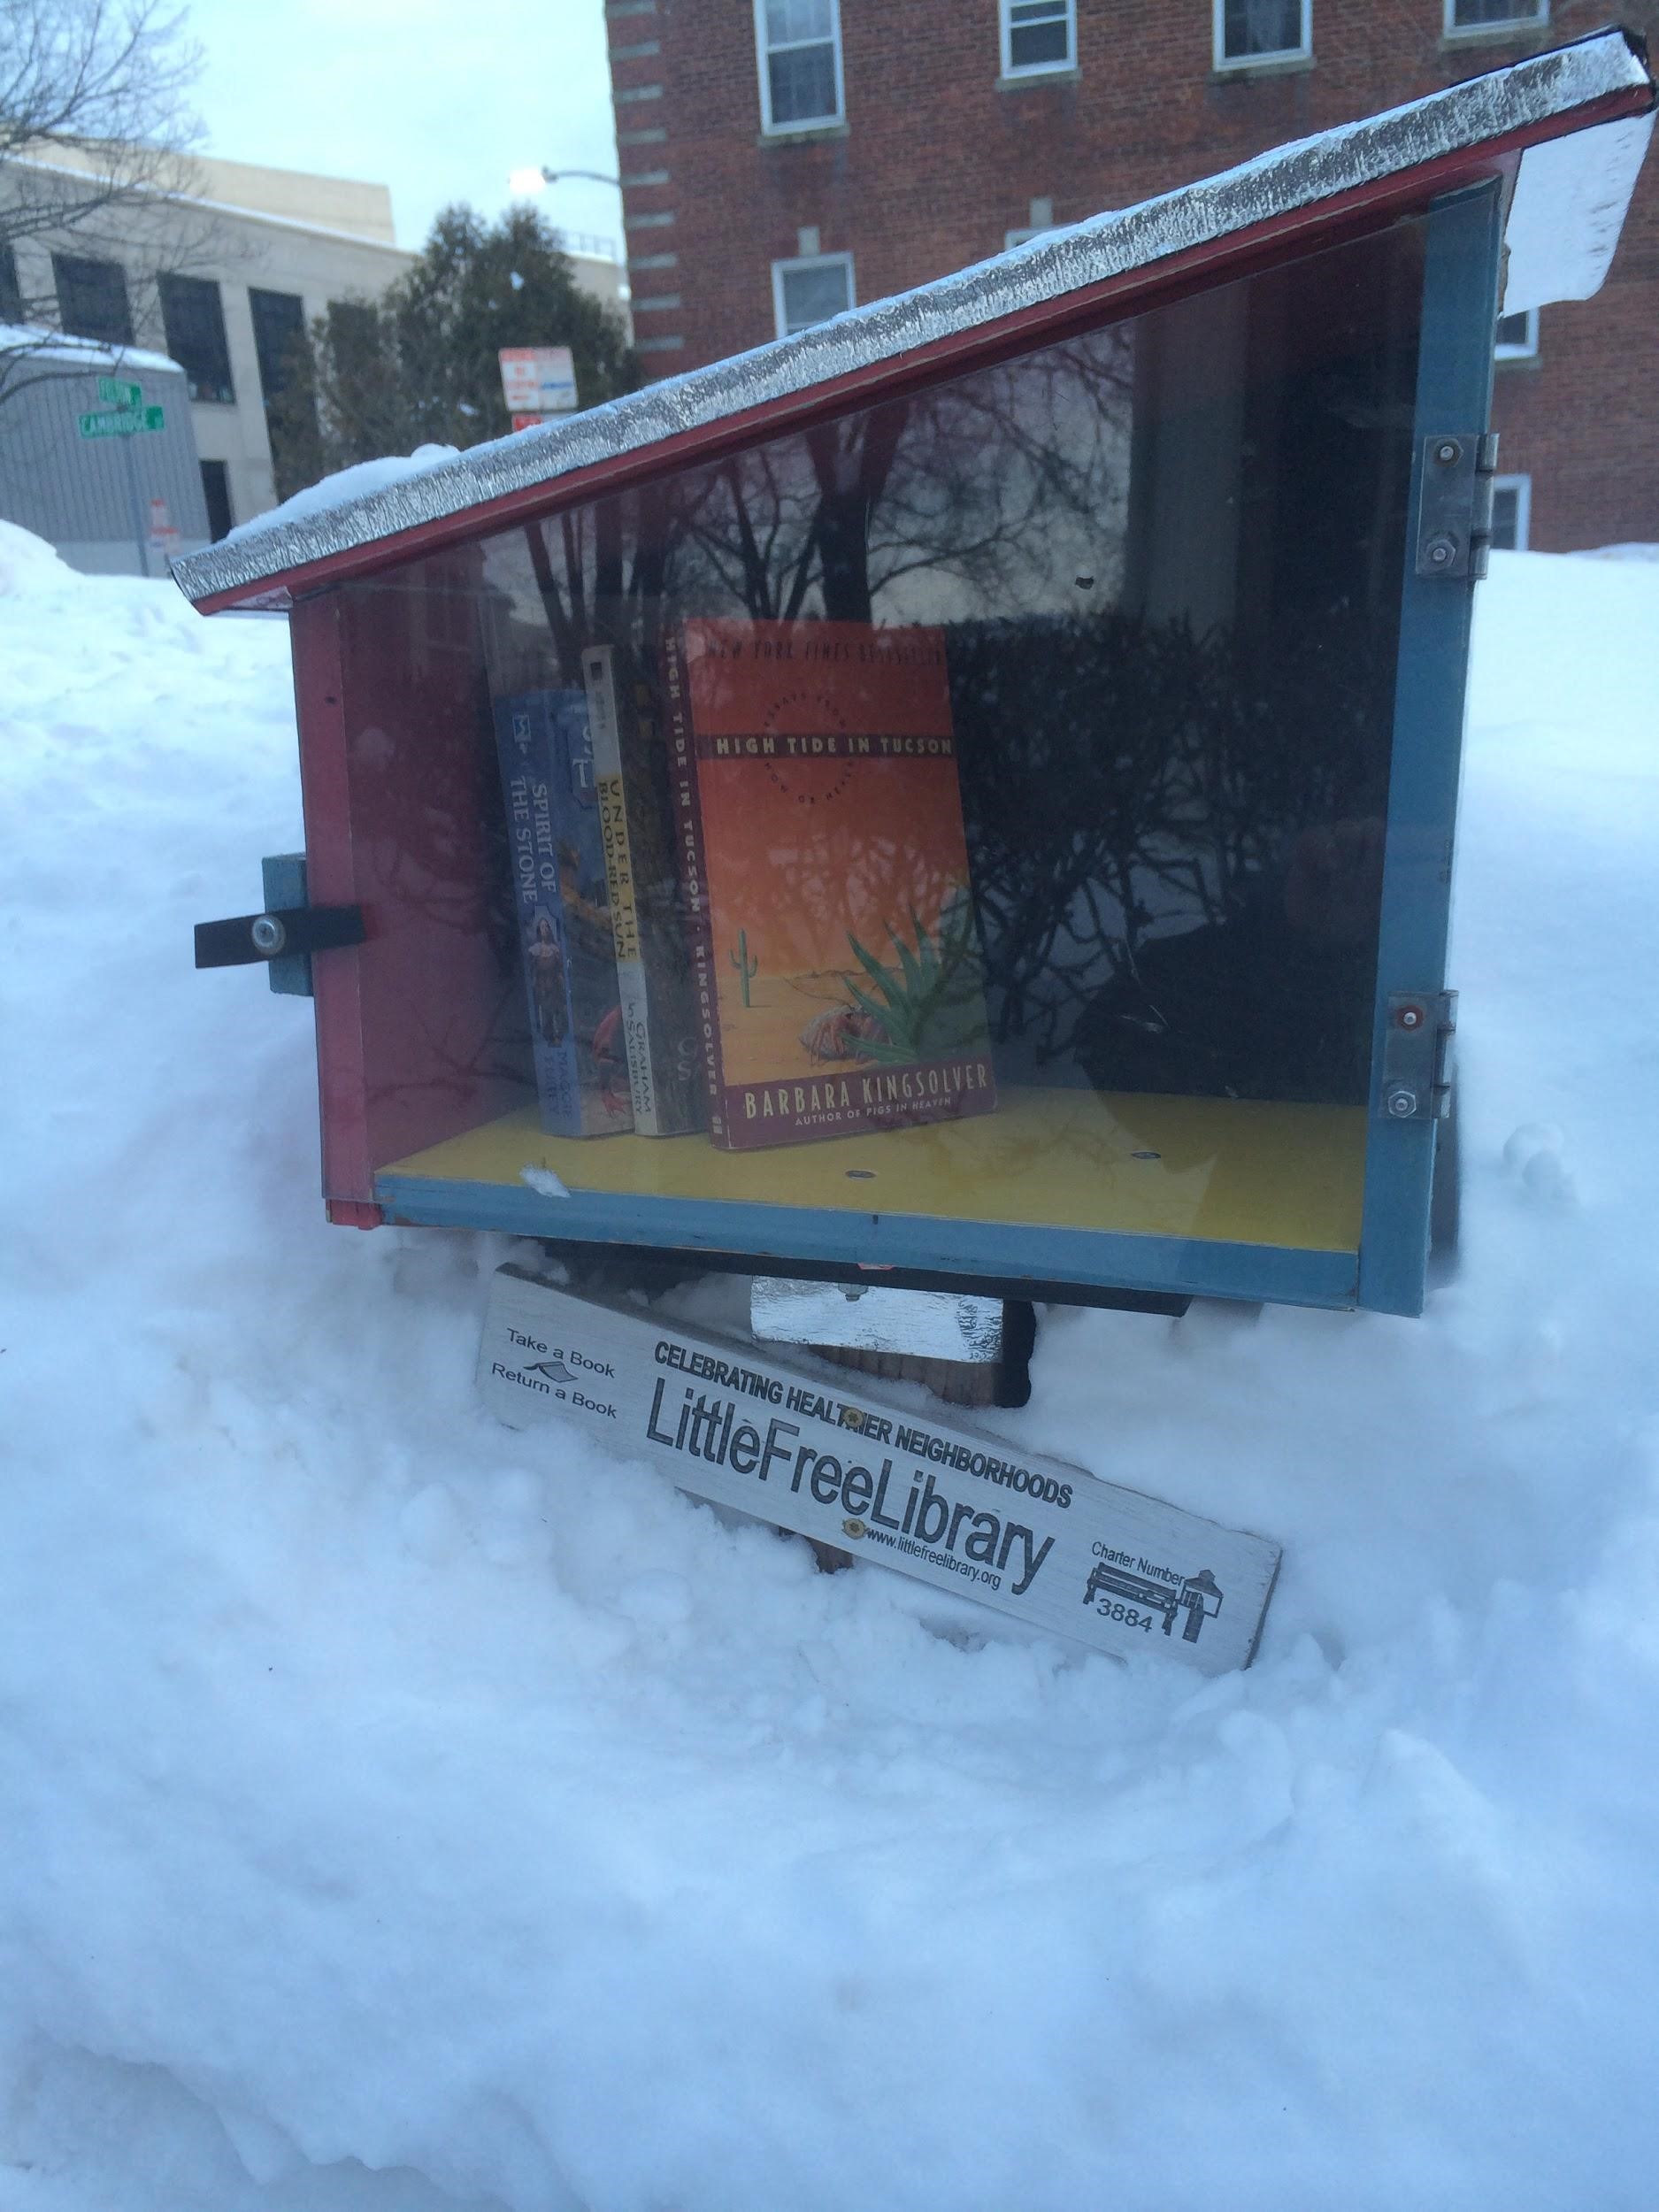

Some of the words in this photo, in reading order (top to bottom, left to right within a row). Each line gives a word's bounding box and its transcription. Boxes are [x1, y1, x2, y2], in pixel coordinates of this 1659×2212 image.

[665, 636, 680, 699] HIGH
[754, 640, 794, 660] YORK
[804, 641, 850, 661] TIMES
[672, 711, 687, 768] TIDE
[716, 737, 775, 755] HIGH
[787, 737, 837, 753] TIDE
[848, 737, 870, 753] IN
[880, 738, 953, 755] TUCSON
[510, 775, 530, 823] THE
[533, 782, 554, 857] SPIRIT
[680, 780, 691, 807] IN
[516, 827, 538, 904] STONE
[540, 862, 557, 894] OF
[597, 781, 619, 904] BLOOD-RED
[612, 910, 626, 958] SUN
[610, 779, 629, 886] UNDER
[622, 905, 637, 957] THE
[684, 820, 700, 912] TUCSON
[695, 946, 717, 1096] KINGSOLVER
[635, 1021, 652, 1113] GRAHAM
[744, 1080, 851, 1120] BARBARA
[860, 1063, 988, 1105] KINGSOLVER
[795, 1112, 842, 1126] AUTHOR
[846, 1108, 861, 1119] OF
[865, 1104, 893, 1117] PIGS
[895, 1102, 908, 1113] IN
[911, 1096, 952, 1110] HEAVEN
[507, 1328, 548, 1354] Take
[552, 1348, 565, 1360] a
[570, 1350, 616, 1379] Book
[491, 1362, 550, 1394] Return
[555, 1388, 566, 1401] a
[572, 1391, 618, 1419] Book
[654, 1340, 784, 1404] CELEBRATING
[785, 1387, 893, 1445] HEALTIER
[894, 1424, 1074, 1509] NEIGHBORHOODS
[646, 1377, 1056, 1596] LittleFreeLibrary
[866, 1527, 1003, 1591] www.littlefreelibrary.org
[1091, 1540, 1137, 1568] Charter
[1136, 1556, 1186, 1587] Number
[1096, 1597, 1154, 1633] 3884
